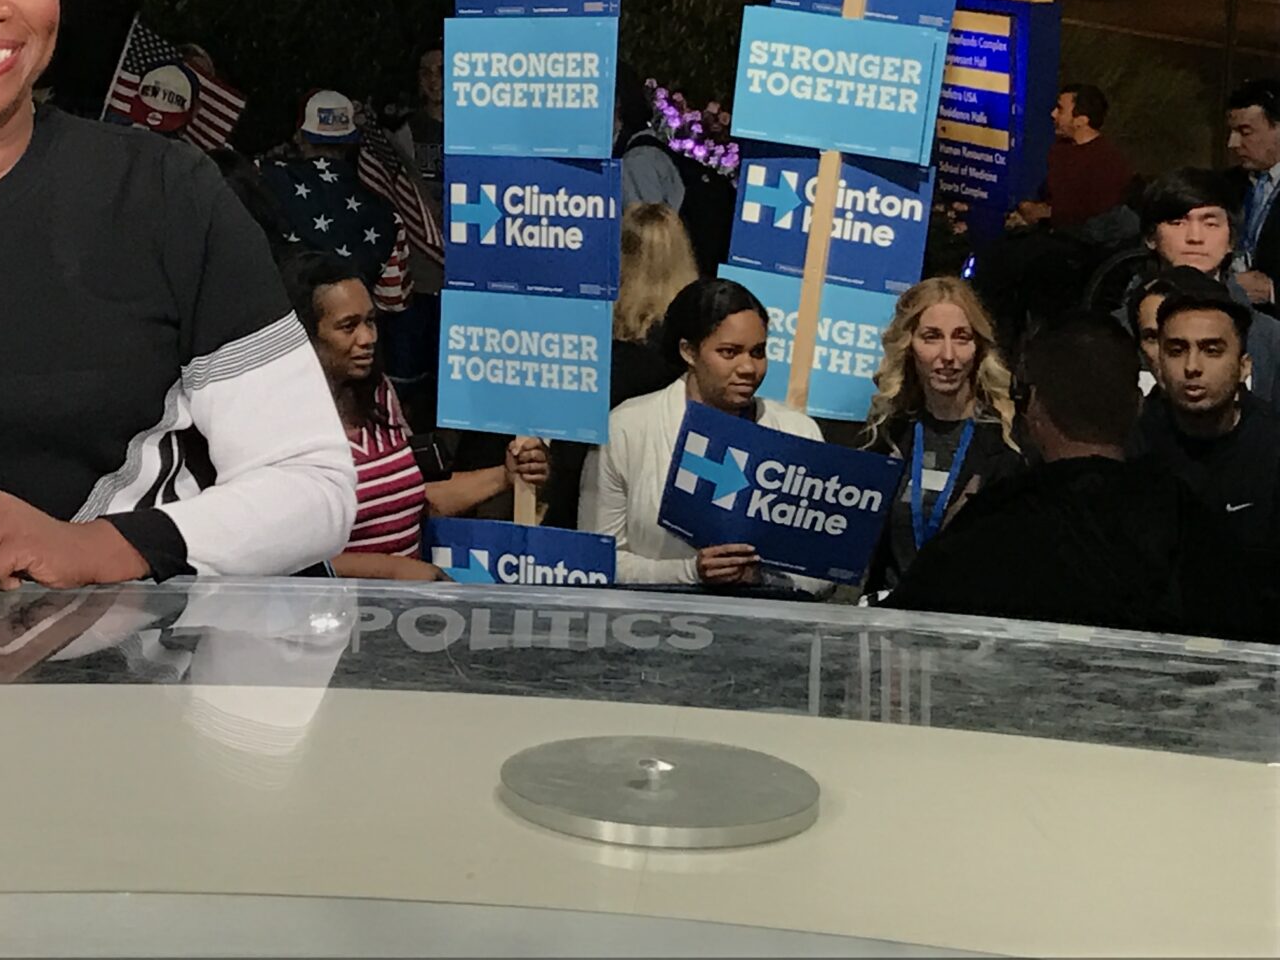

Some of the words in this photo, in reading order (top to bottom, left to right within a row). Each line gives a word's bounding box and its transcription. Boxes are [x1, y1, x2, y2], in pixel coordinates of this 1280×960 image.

[453, 52, 599, 78] STRONGER
[749, 40, 922, 85] STRONGER
[162, 89, 187, 108] YORK
[453, 82, 599, 108] TOGETHER
[746, 69, 918, 114] TOGETHER
[503, 185, 603, 218] Clinton
[805, 176, 923, 222] Cinton
[505, 217, 584, 250] Kaine
[448, 325, 598, 362] STRONGER
[448, 355, 598, 392] TOGETHER
[755, 459, 883, 512] Clinton
[747, 489, 848, 536] Kaine
[352, 606, 715, 654] POLITICS
